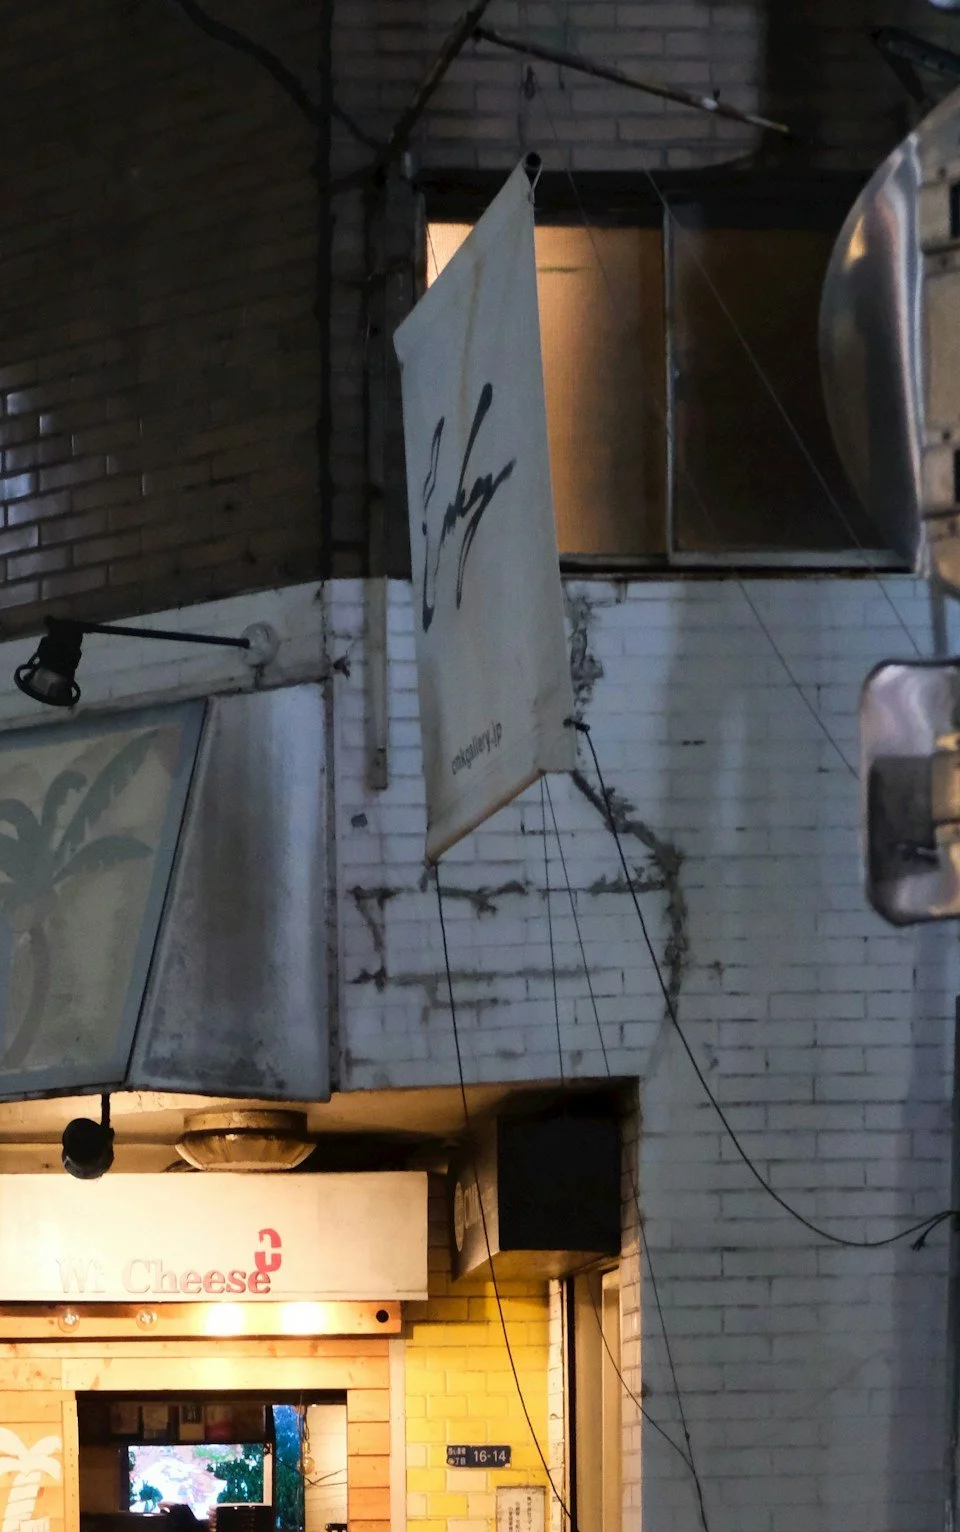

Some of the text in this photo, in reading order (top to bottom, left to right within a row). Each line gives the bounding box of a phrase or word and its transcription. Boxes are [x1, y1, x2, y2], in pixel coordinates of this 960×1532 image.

[121, 1258, 271, 1294] Cheese
[448, 1457, 467, 1466] 丁目
[474, 1450, 507, 1463] 16-14
